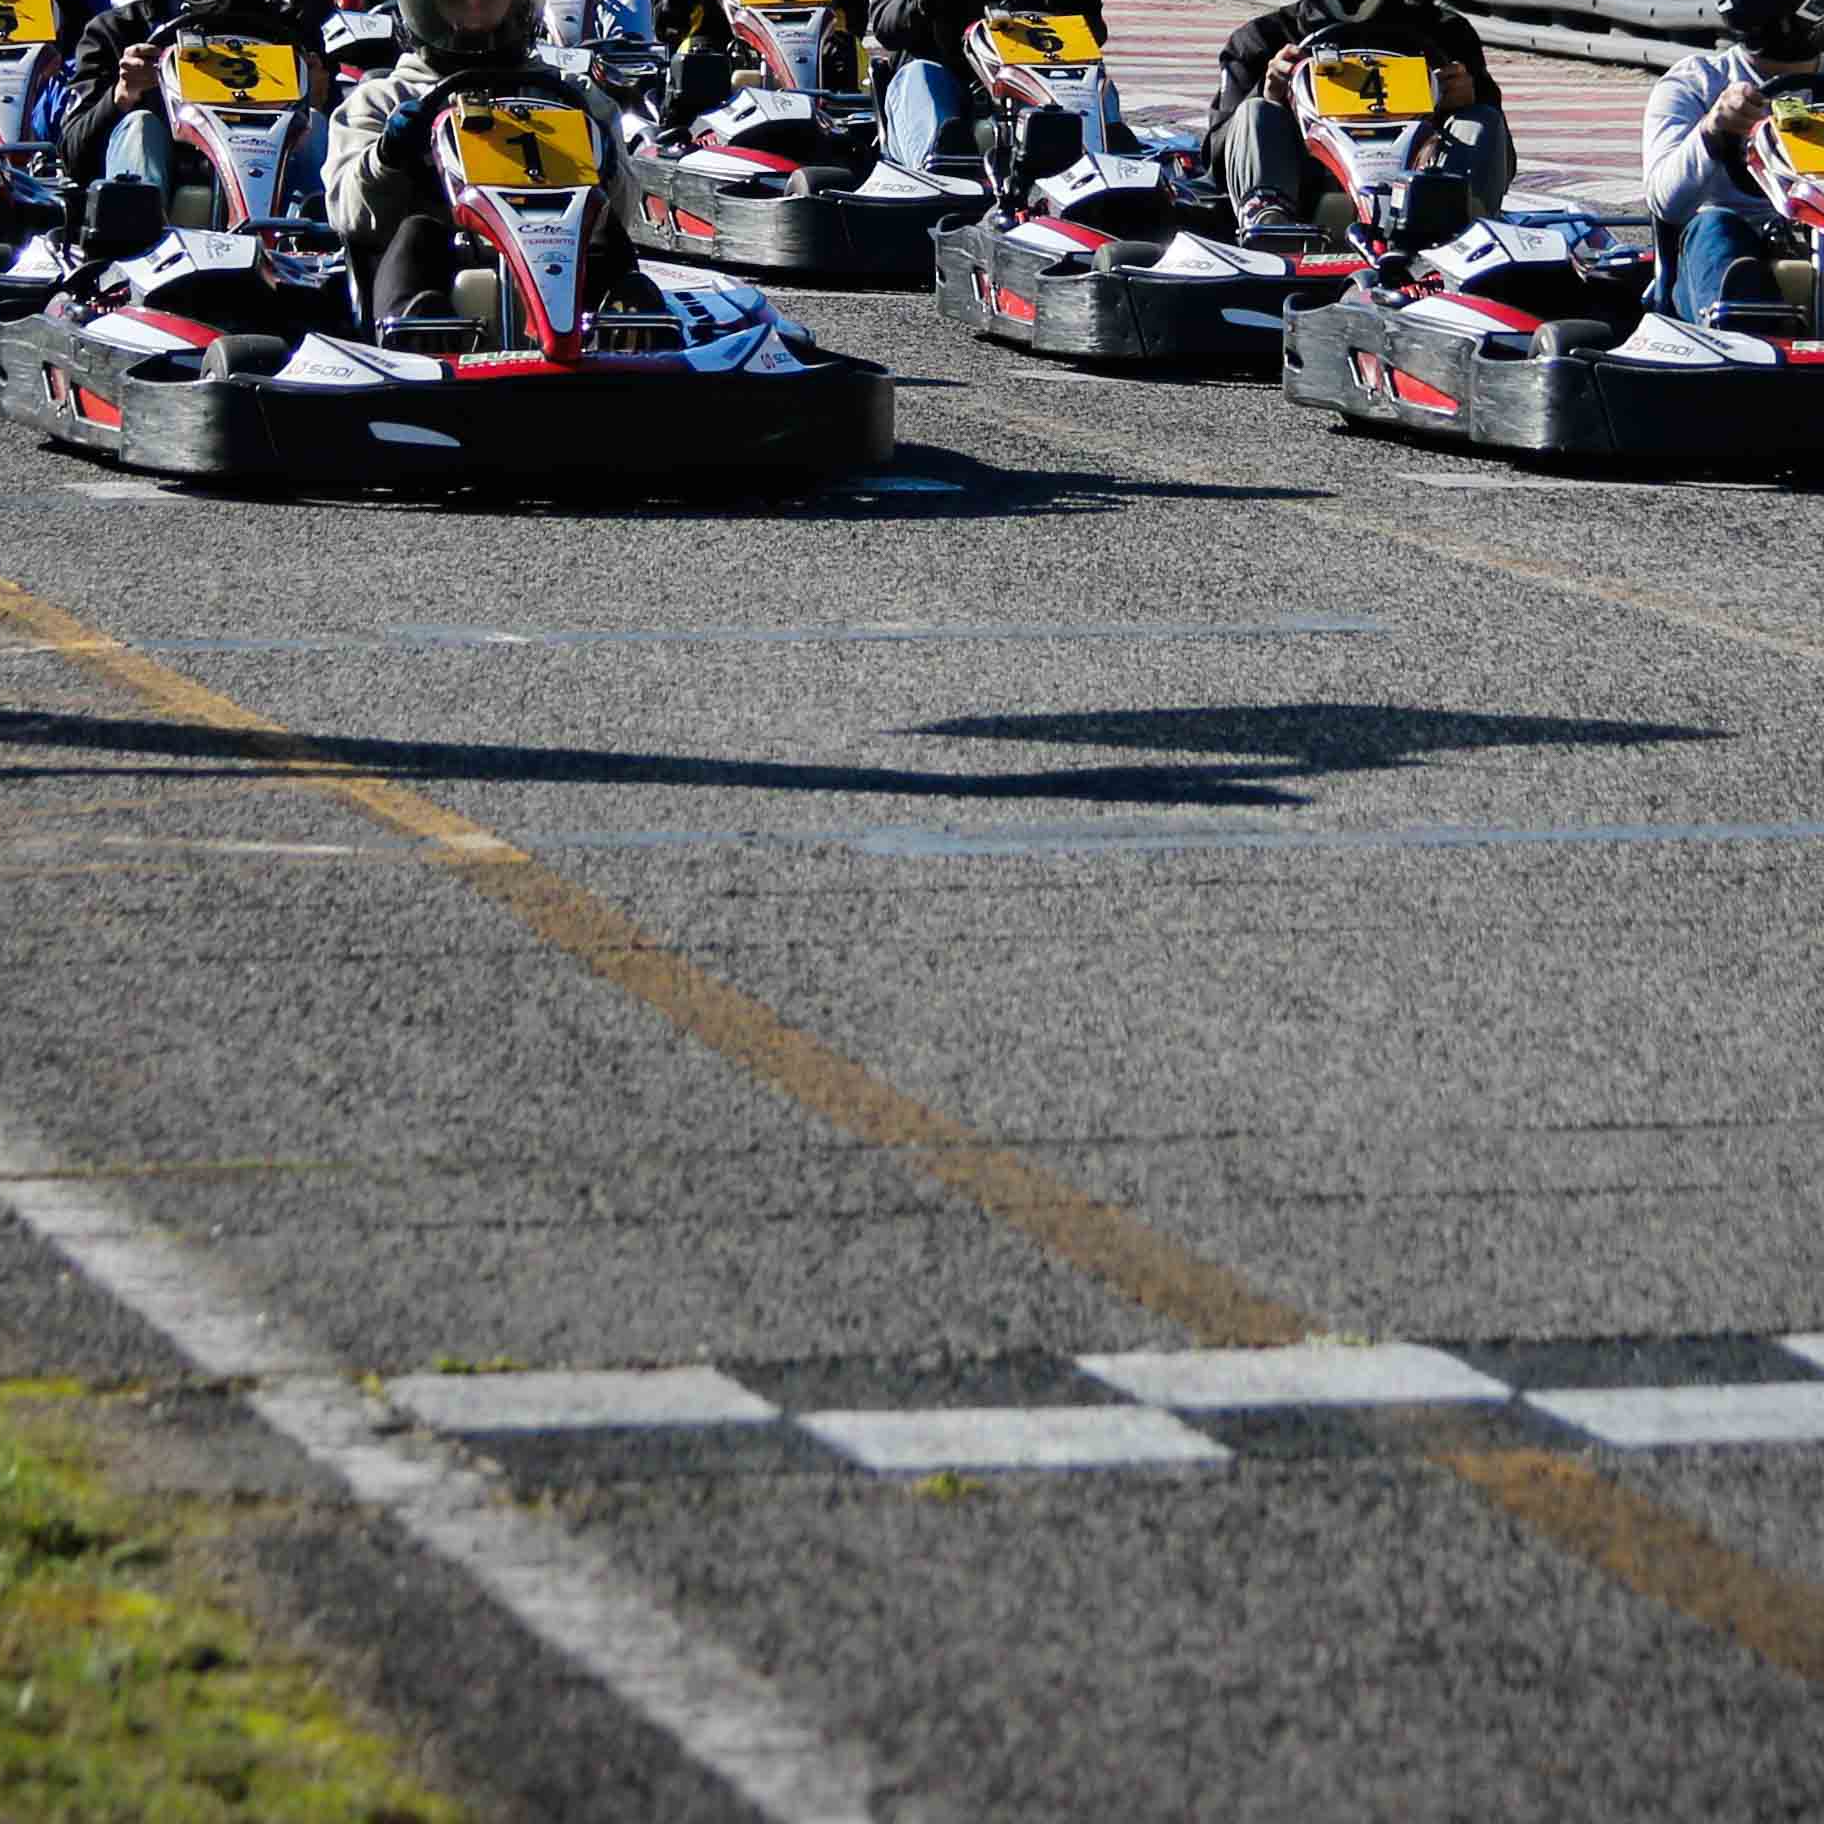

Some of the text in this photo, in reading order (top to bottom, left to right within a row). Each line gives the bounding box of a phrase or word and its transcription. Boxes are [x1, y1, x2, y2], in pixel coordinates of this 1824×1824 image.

[1027, 26, 1064, 53] 6
[506, 132, 546, 183] 1
[1647, 342, 1696, 357] SODI
[309, 363, 354, 379] SODI
